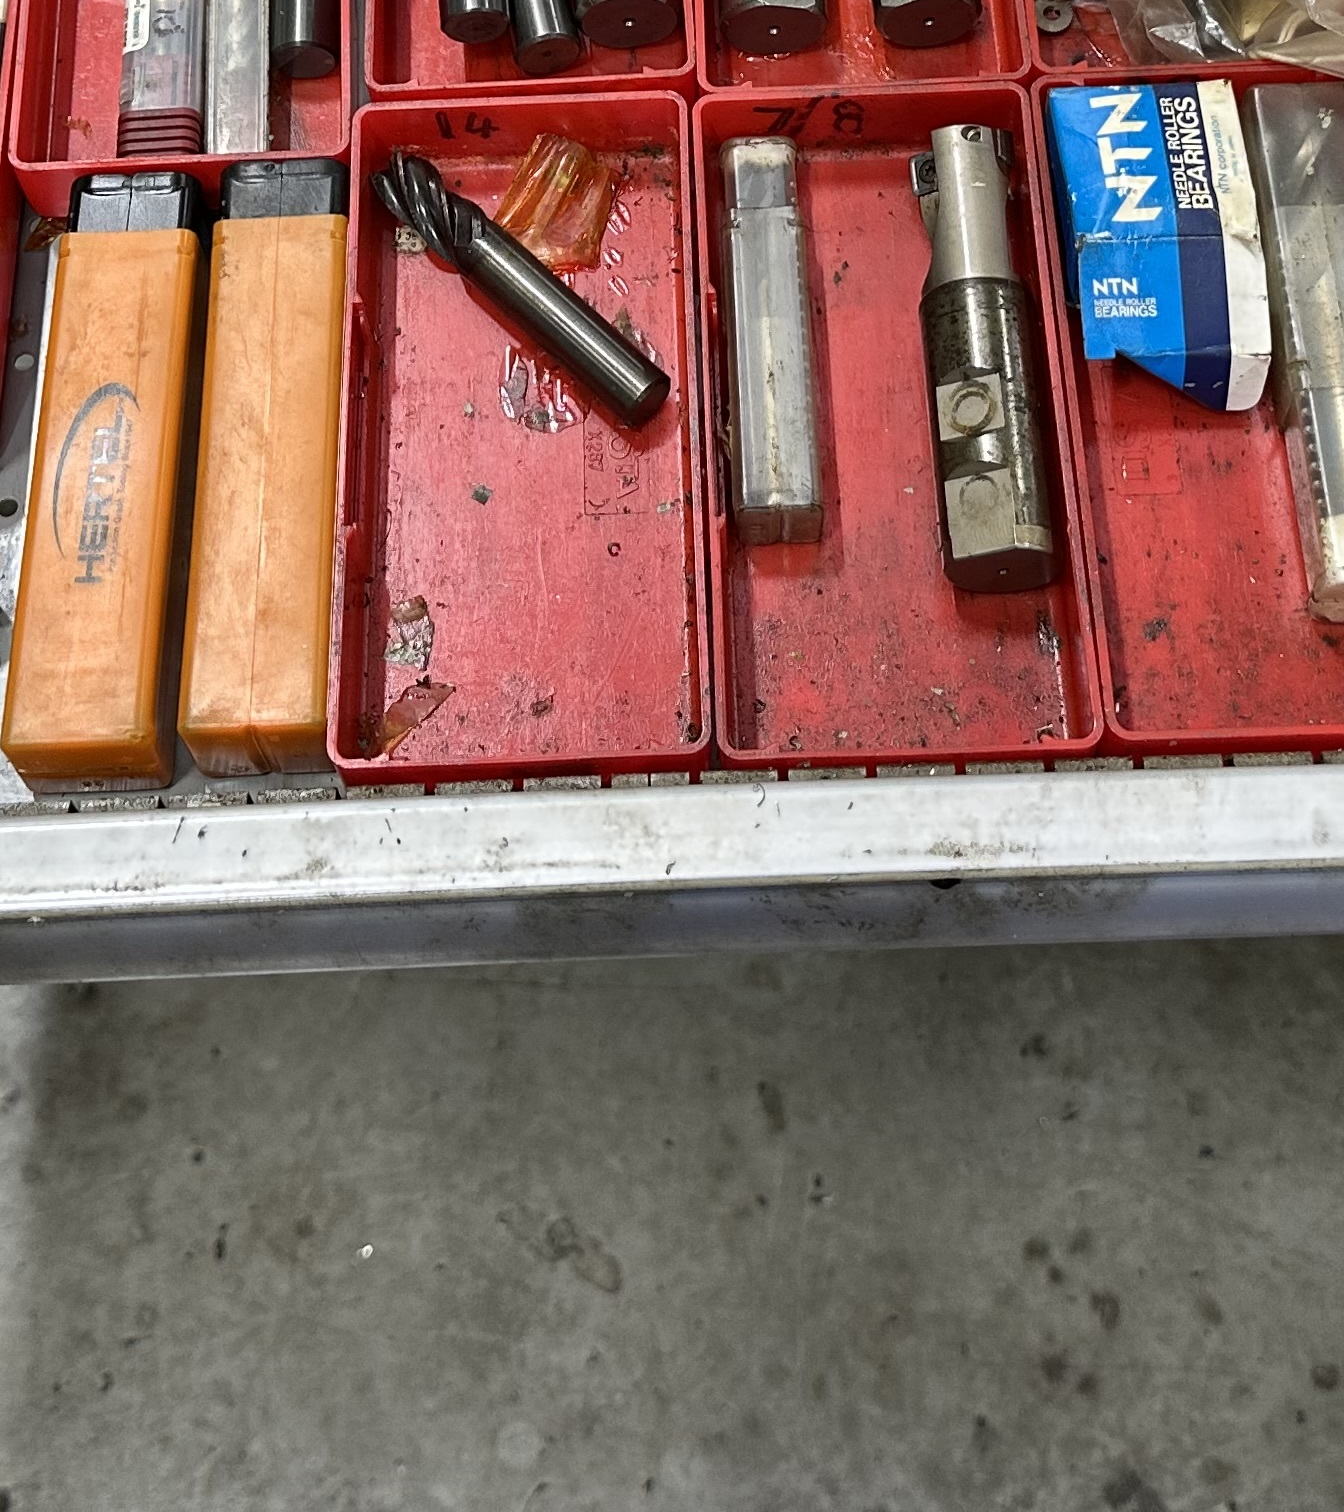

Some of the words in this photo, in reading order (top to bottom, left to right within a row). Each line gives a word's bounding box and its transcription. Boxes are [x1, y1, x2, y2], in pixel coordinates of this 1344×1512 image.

[1159, 96, 1183, 150] ROLLER
[1208, 113, 1227, 170] corporation
[1089, 93, 1163, 223] NTN
[1169, 151, 1193, 209] NEEDLE
[1173, 96, 1213, 209] BEARINGS
[1216, 171, 1231, 194] NTN
[1092, 277, 1139, 296] NTN
[1094, 304, 1158, 318] BEARINGS
[72, 411, 124, 586] HERTEL
